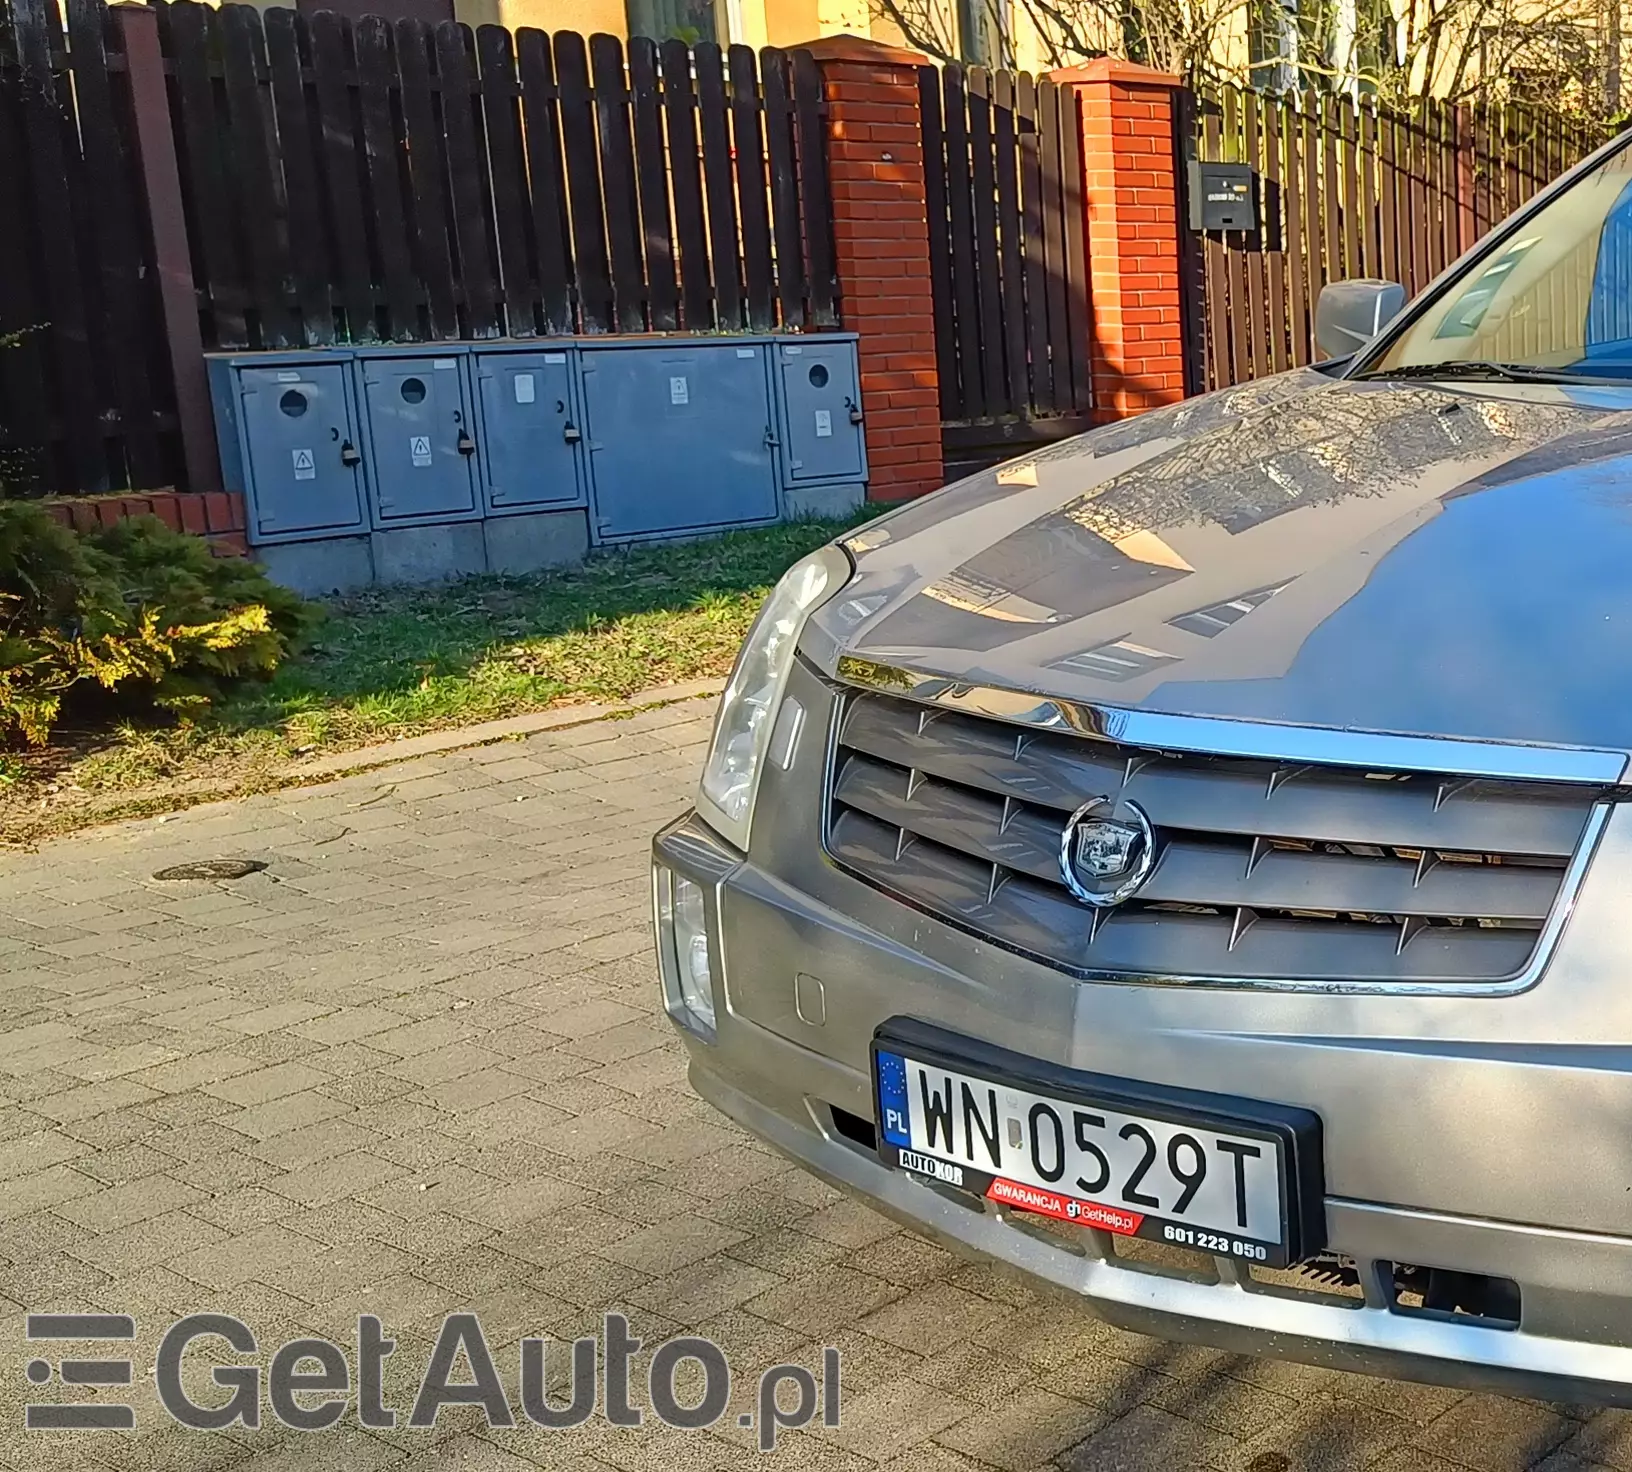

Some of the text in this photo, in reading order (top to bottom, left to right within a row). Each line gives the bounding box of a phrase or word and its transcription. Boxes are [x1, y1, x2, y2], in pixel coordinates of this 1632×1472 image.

[886, 1108, 908, 1134] PL
[918, 1069, 1261, 1229] WN 0529T
[993, 1182, 1062, 1213] GWARANCJA
[1081, 1205, 1134, 1230] GetHelp.pl
[1163, 1225, 1267, 1261] 601 223 050
